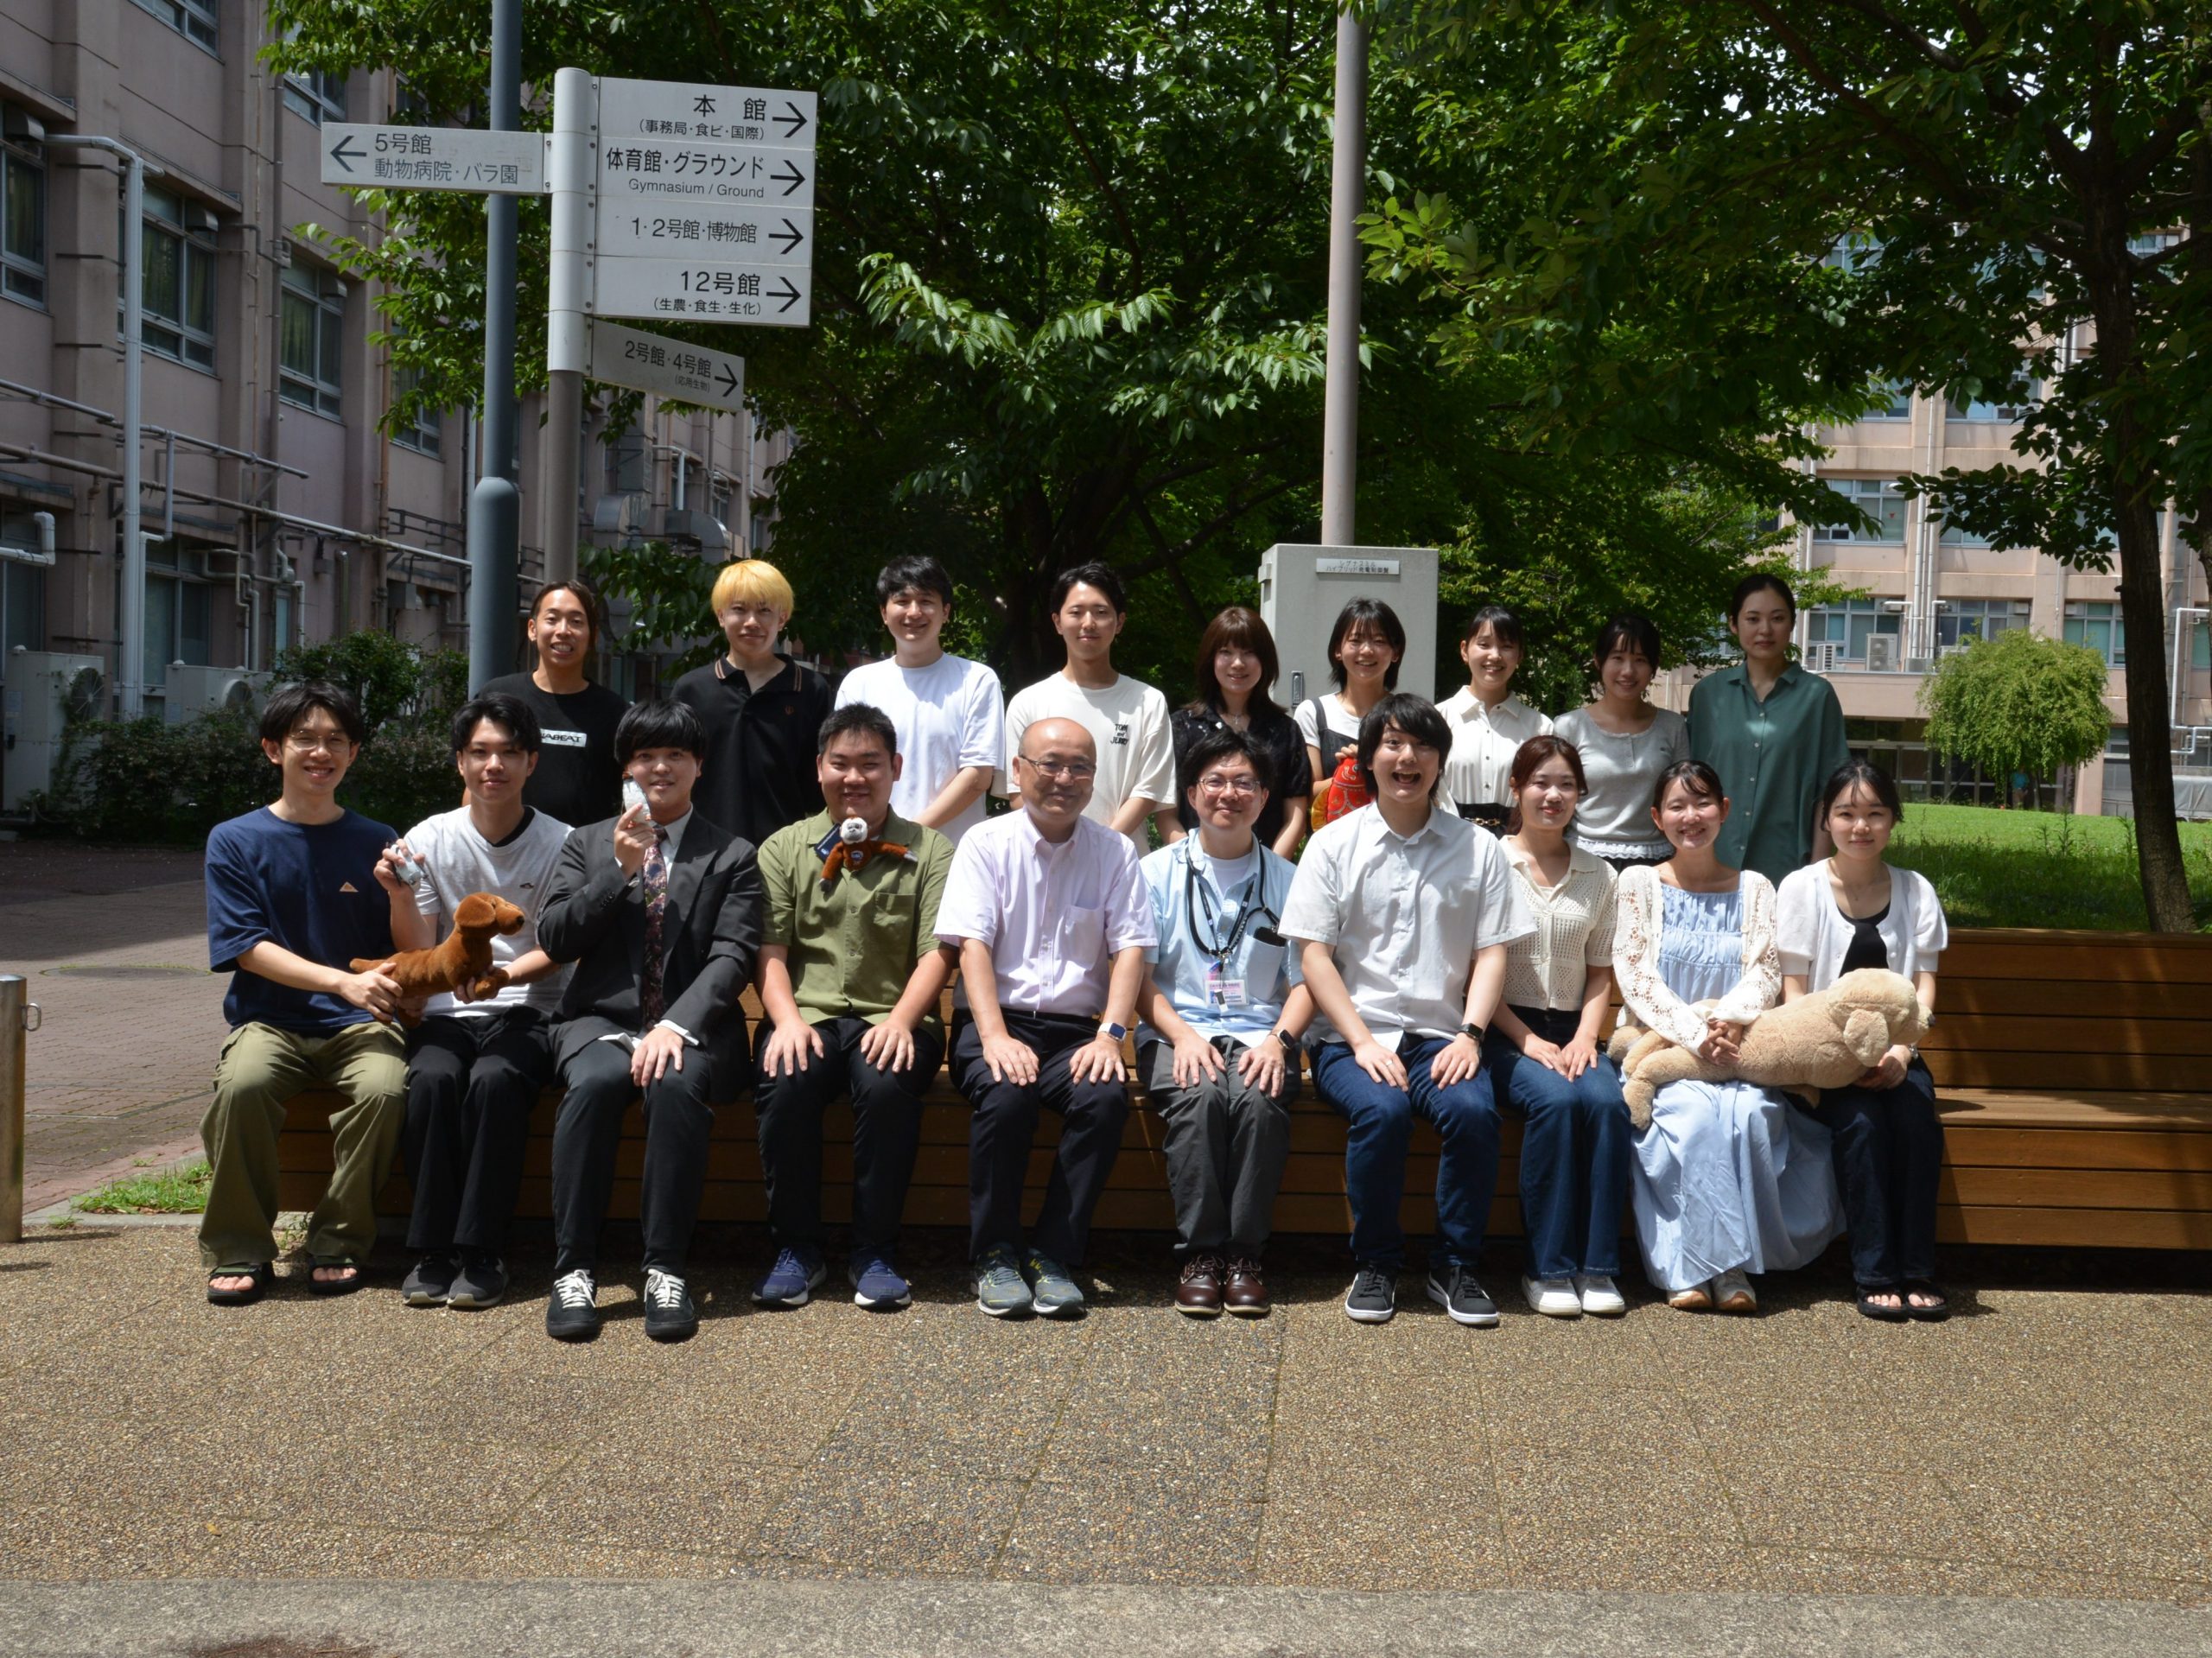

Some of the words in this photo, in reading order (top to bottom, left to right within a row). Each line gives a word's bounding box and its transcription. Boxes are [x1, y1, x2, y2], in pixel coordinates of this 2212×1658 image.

[639, 118, 765, 141] （事務局・食ビ・国際）
[374, 132, 432, 156] 5号館
[374, 157, 518, 185] 動物病院・バラ園
[606, 147, 764, 180] 体育館・グラウンド
[628, 178, 705, 194] Gymnasium
[716, 183, 764, 199] Ground
[680, 270, 761, 297] 12号館
[653, 297, 762, 316] （生農・食生・生化）
[624, 340, 712, 378] 2号館・4号館
